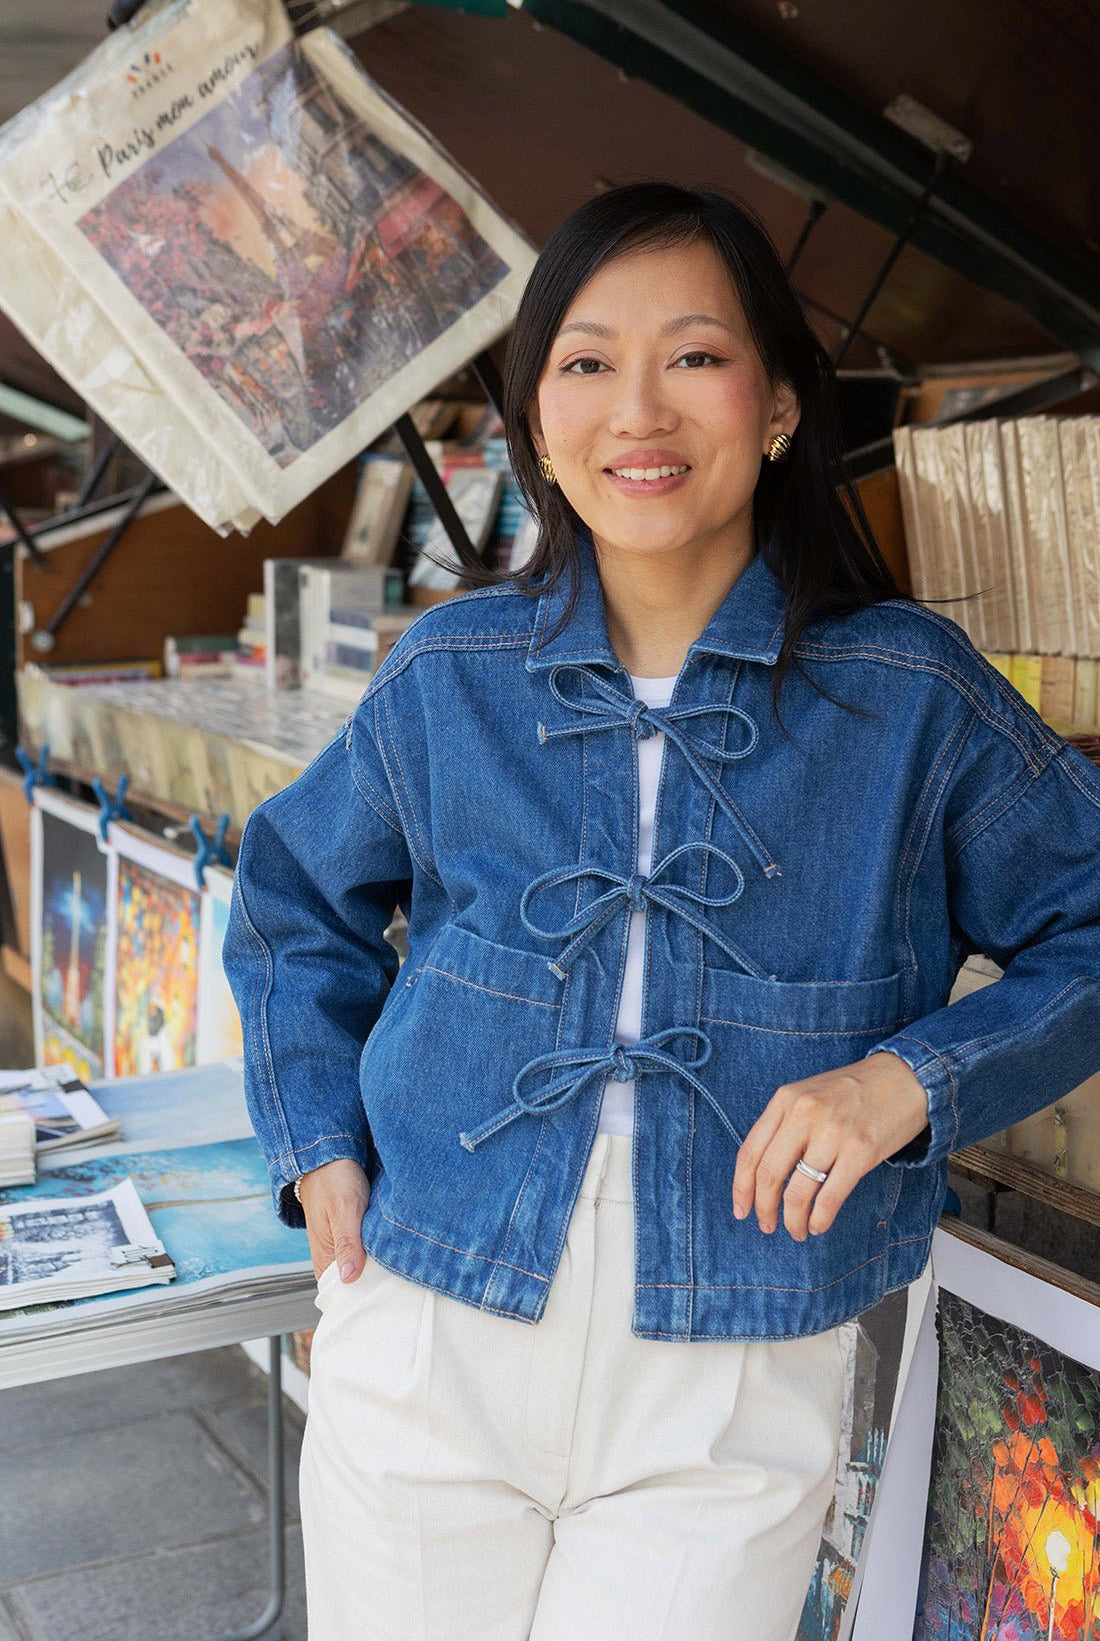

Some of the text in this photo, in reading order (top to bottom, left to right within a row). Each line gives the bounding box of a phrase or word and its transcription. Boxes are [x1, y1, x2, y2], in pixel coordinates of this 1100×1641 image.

[97, 43, 259, 178] Paris mon amour
